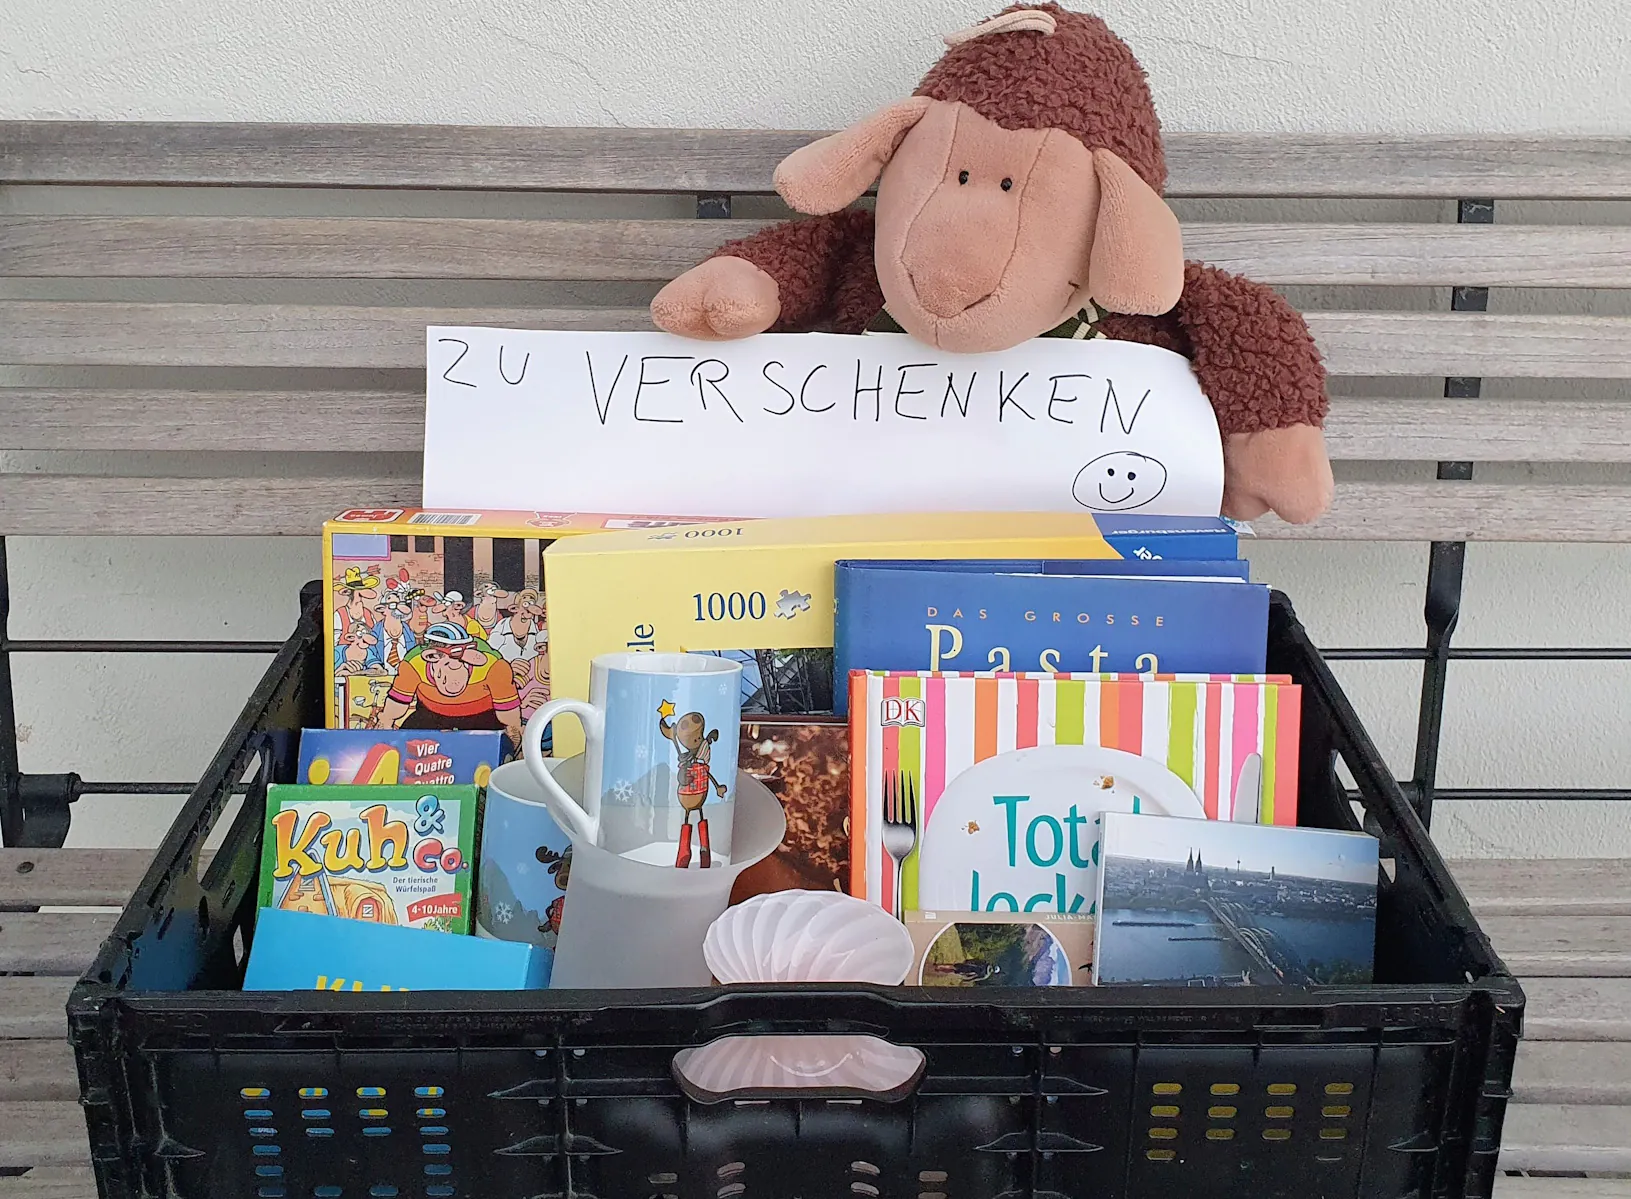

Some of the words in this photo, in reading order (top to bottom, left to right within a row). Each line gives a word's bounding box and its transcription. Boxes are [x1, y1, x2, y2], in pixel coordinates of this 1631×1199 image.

[438, 338, 530, 388] ZU
[585, 351, 1151, 435] VERSCHENKEN
[684, 527, 744, 539] 1000
[692, 591, 767, 622] 1000
[927, 606, 988, 620] DAS
[1024, 610, 1164, 627] GROSSE
[884, 698, 922, 723] DK
[416, 742, 441, 757] Vier
[414, 758, 453, 776] Quatre
[271, 804, 410, 881] Kuh
[413, 794, 446, 837] &
[392, 876, 406, 884] Der
[407, 876, 439, 884] tierische
